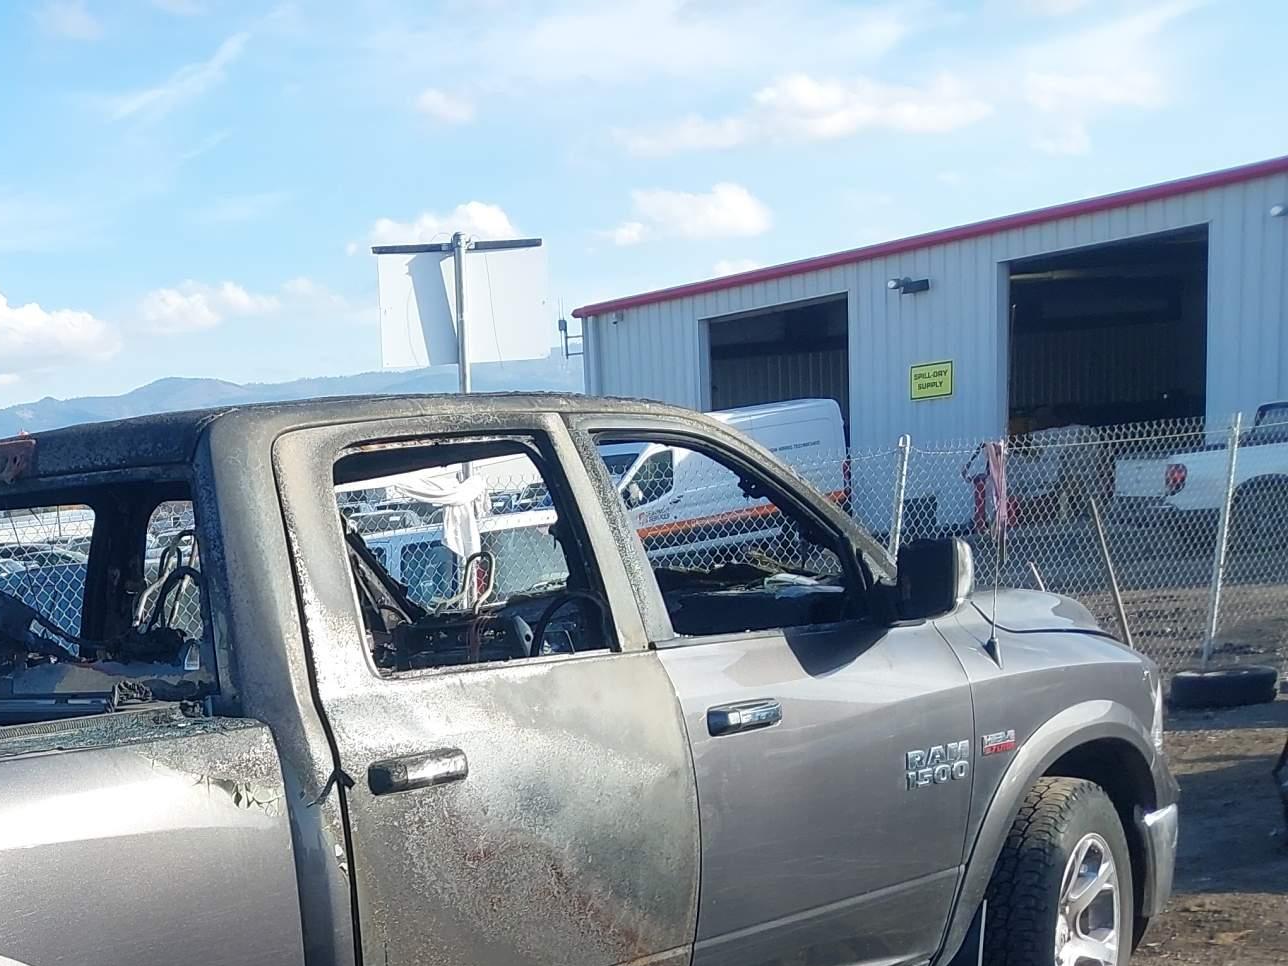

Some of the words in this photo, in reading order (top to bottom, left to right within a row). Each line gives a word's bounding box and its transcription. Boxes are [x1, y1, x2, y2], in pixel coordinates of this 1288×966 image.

[917, 380, 944, 391] SUPPLY
[905, 740, 970, 770] RAM
[905, 760, 970, 791] 1500
